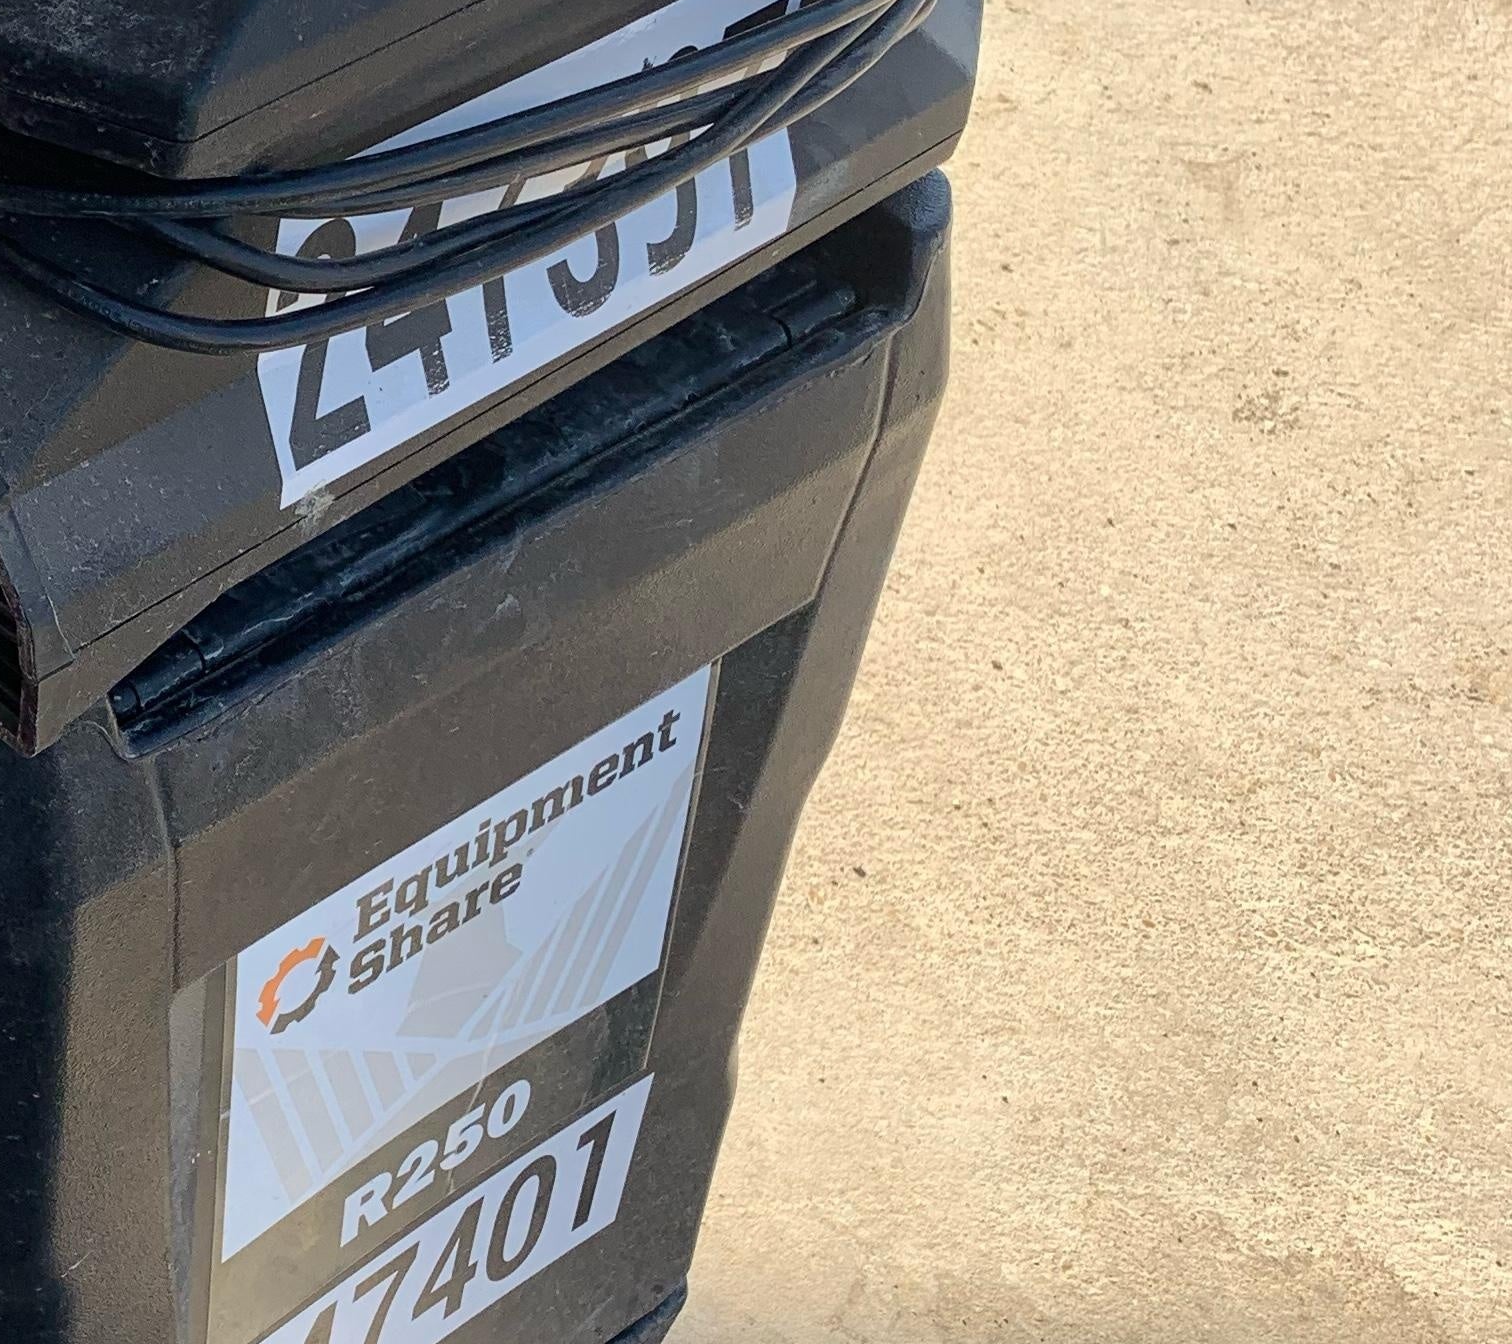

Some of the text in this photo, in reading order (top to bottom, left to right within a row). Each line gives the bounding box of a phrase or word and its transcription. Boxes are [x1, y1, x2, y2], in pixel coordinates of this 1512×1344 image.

[353, 707, 681, 942] Equipment
[348, 862, 523, 995] Share
[339, 1078, 531, 1248] R250
